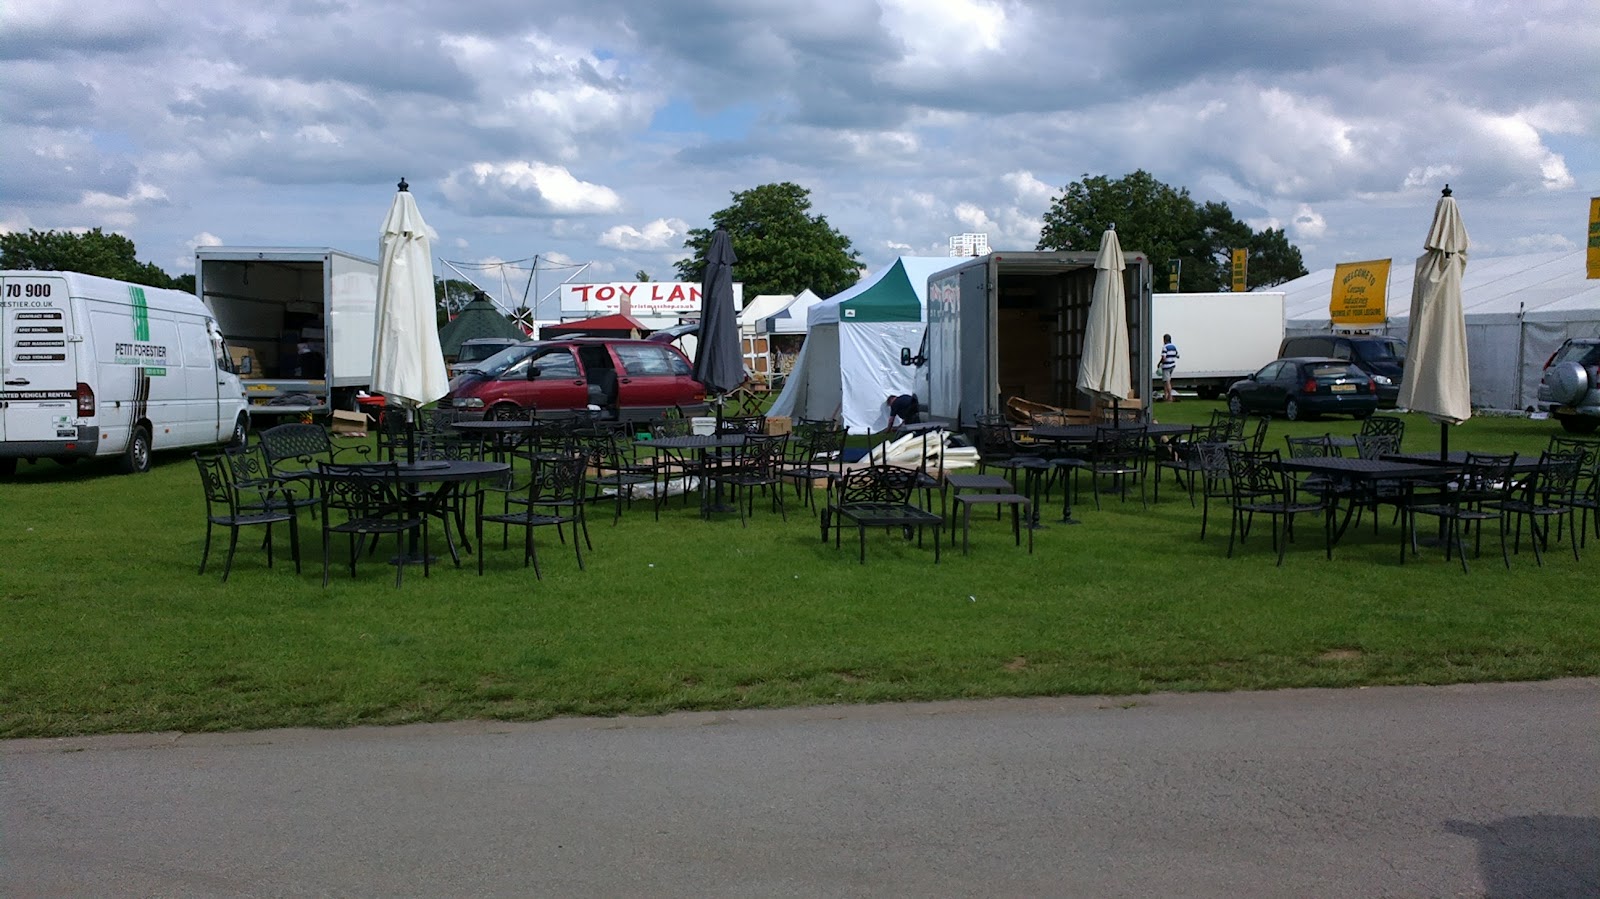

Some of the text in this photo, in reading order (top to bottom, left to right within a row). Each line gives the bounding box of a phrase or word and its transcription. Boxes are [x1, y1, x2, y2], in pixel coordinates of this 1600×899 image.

[1343, 268, 1370, 285] WELCOME
[6, 284, 51, 297] 70 900
[571, 285, 703, 302] TOY LAN
[115, 343, 166, 357] PETIT FORESTIER
